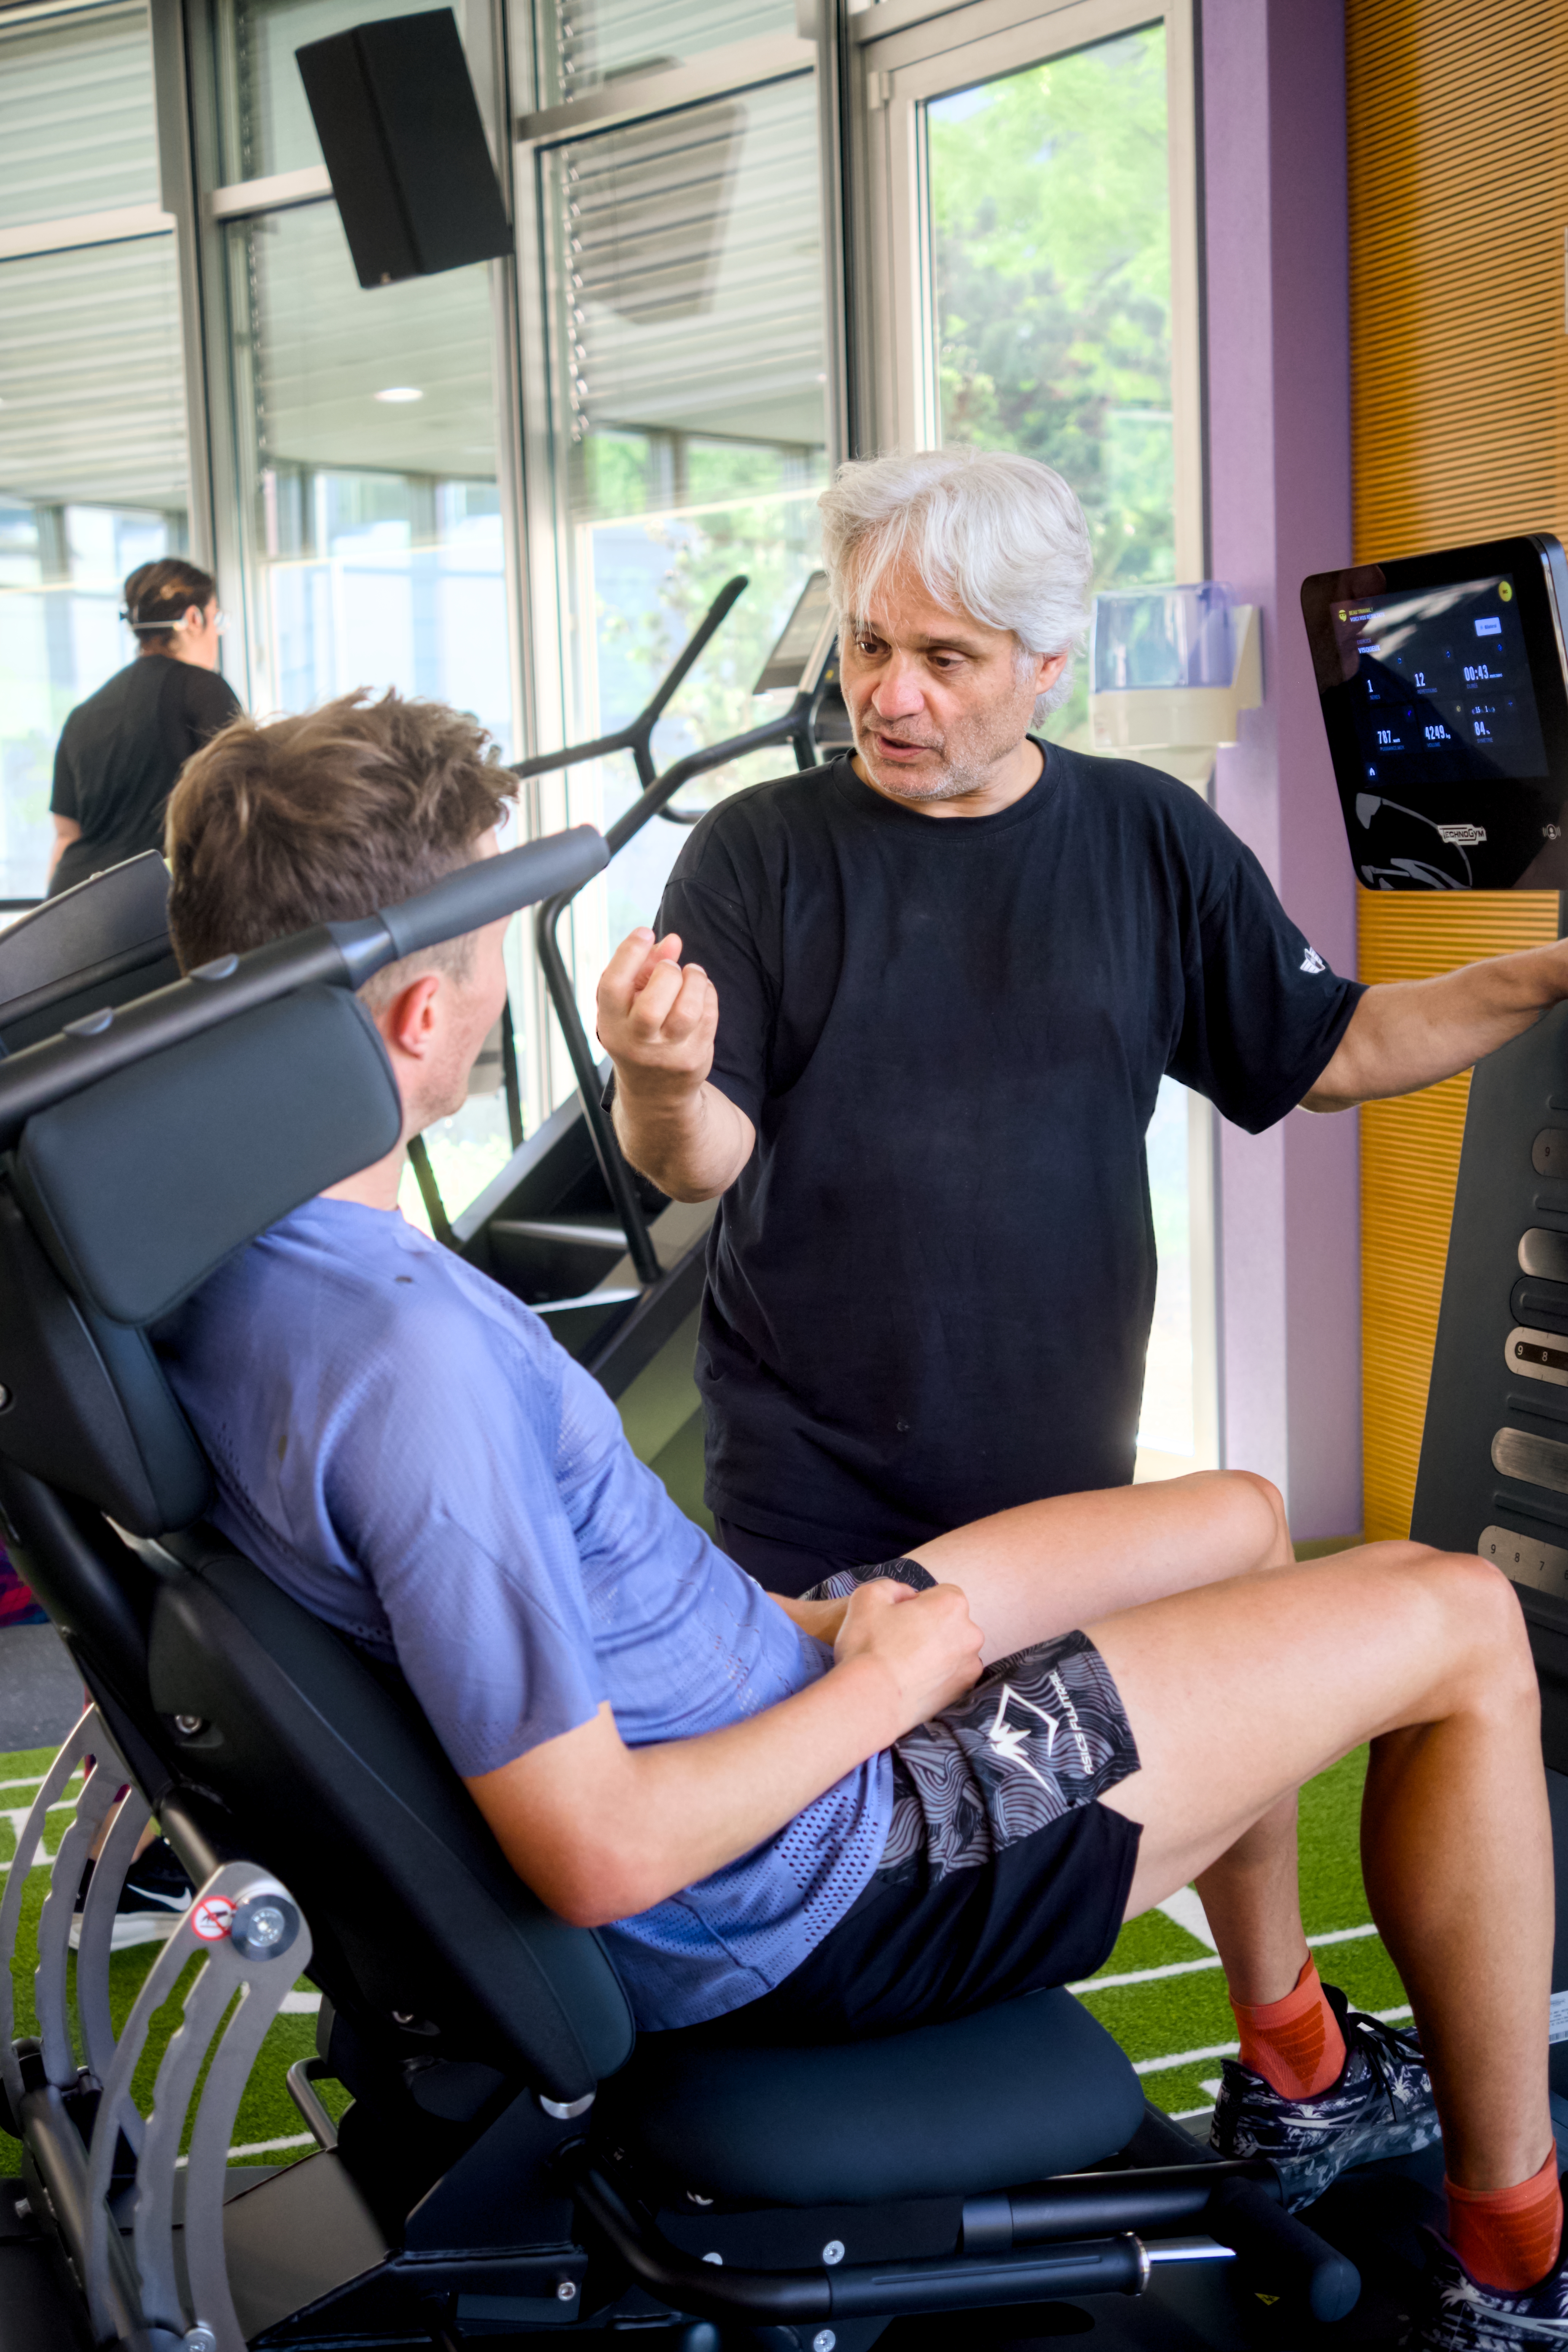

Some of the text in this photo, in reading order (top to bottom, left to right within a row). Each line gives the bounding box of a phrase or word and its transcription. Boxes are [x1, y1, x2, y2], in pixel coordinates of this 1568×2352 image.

[1358, 645, 1380, 653] VISQUEUX
[1415, 672, 1426, 687] 12
[1464, 664, 1489, 681] 00:43
[1367, 679, 1374, 693] 1
[1425, 725, 1445, 740] 4249
[1474, 721, 1486, 736] 84
[1377, 730, 1391, 744] 787
[1545, 1147, 1550, 1157] 9
[1517, 1345, 1548, 1362] 9 8
[1491, 1544, 1496, 1554] 9
[1515, 1552, 1520, 1562] 8
[1539, 1561, 1545, 1571] 7
[1049, 1671, 1094, 1775] ASICS FUJITRAIL
